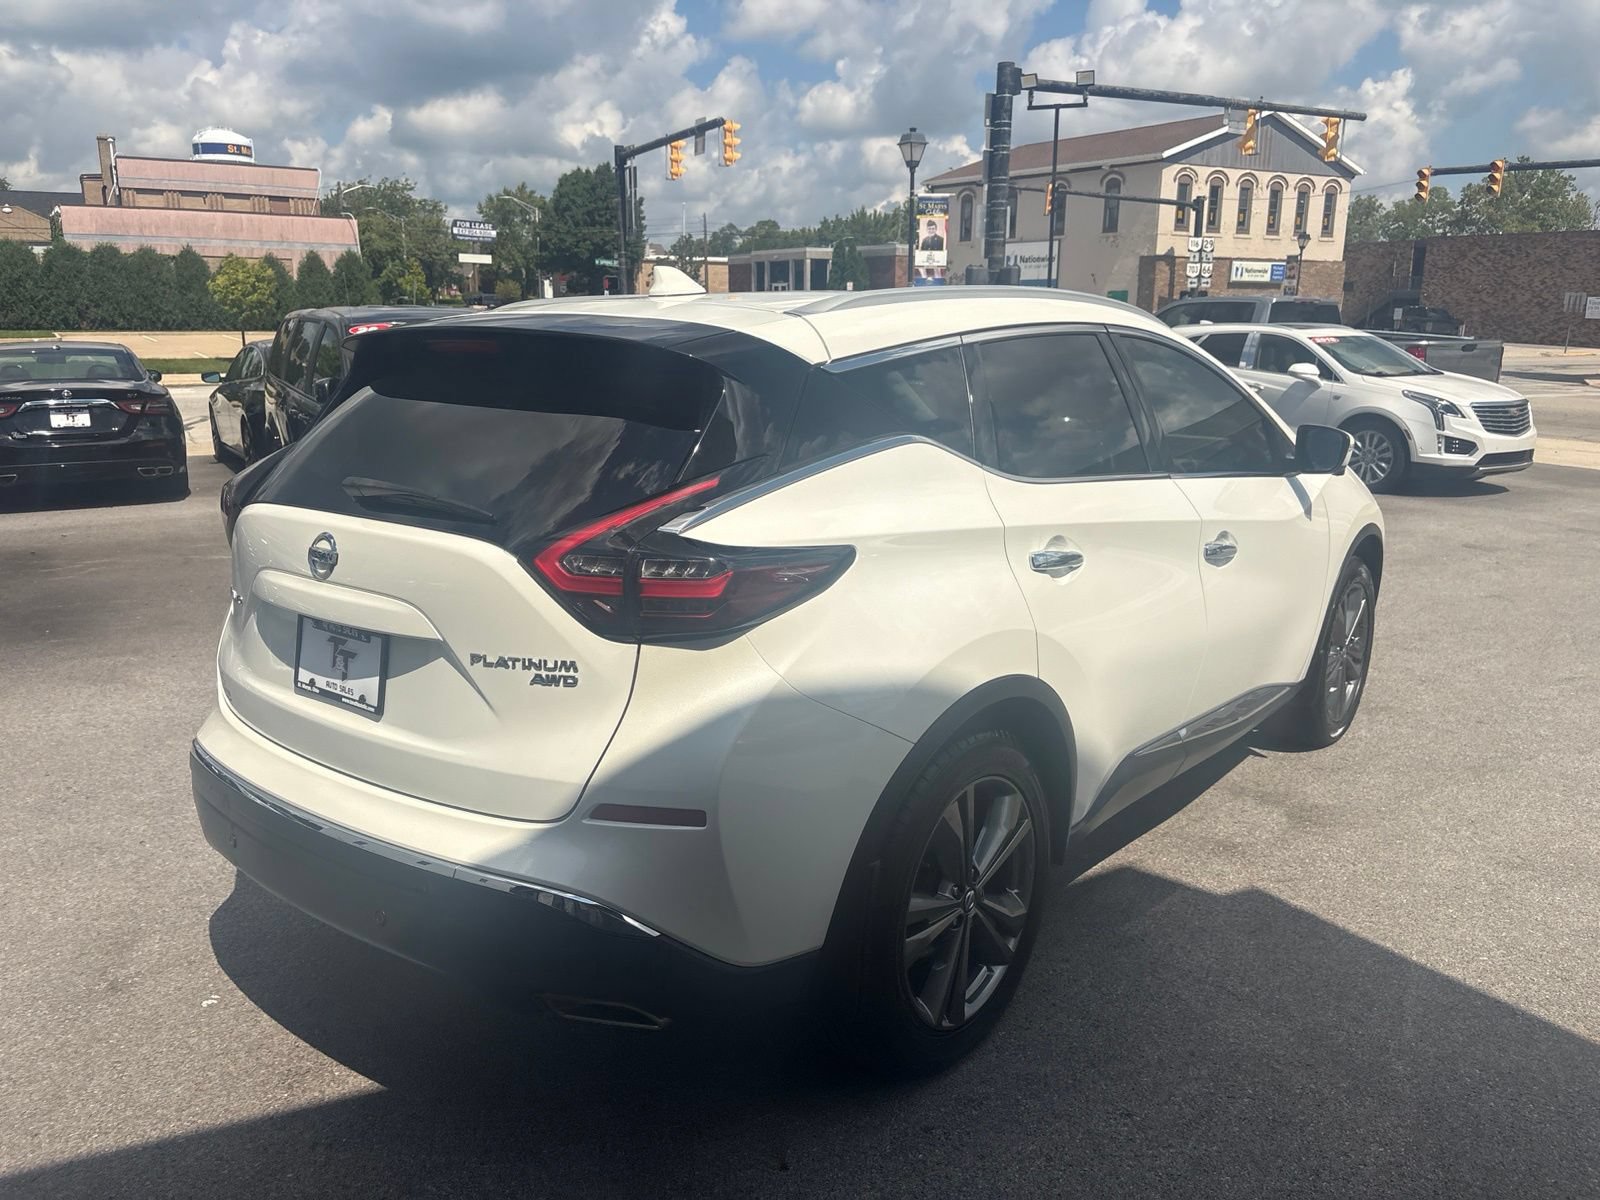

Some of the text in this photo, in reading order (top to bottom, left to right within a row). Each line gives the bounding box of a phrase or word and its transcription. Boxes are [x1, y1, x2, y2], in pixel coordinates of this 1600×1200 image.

[456, 220, 493, 230] FOR LEASE
[1190, 239, 1199, 248] 116
[1204, 239, 1214, 249] 29
[1189, 265, 1199, 274] 703
[1202, 265, 1211, 275] 66
[469, 653, 579, 674] PLATINUM
[529, 673, 579, 688] AWD
[325, 680, 355, 696] AUTO SALES
